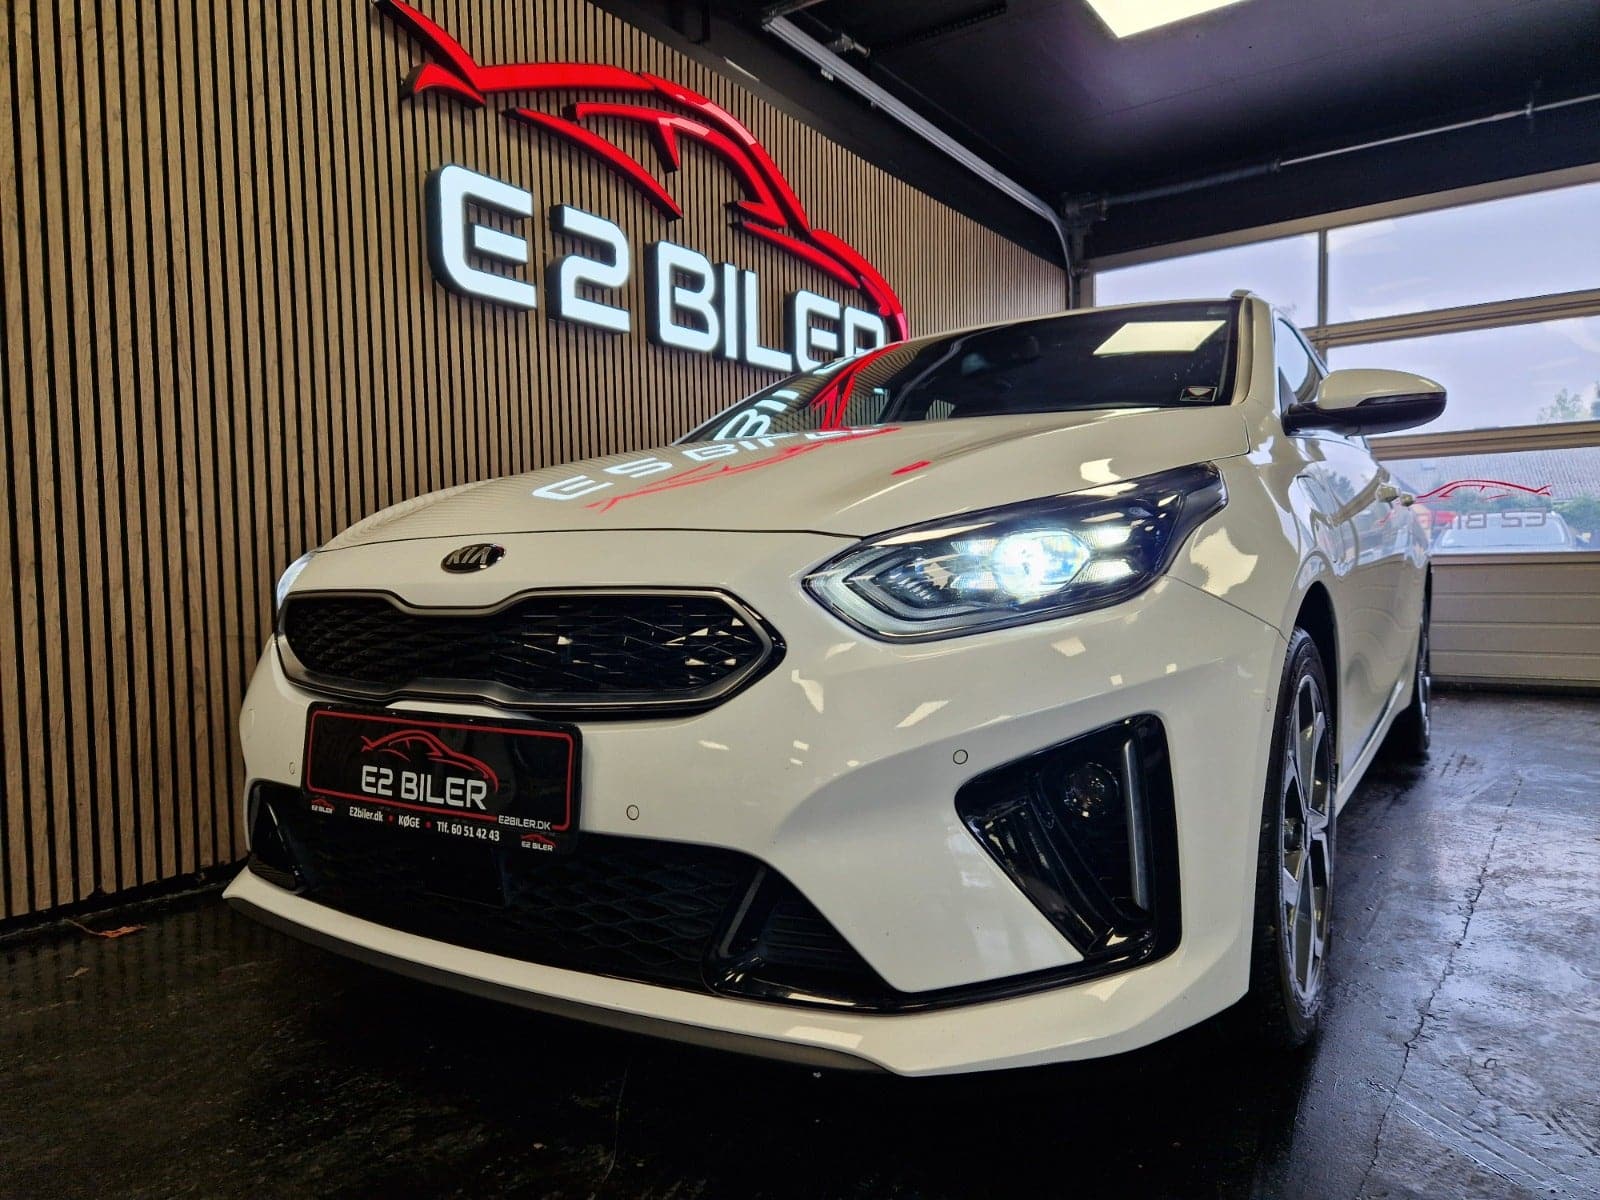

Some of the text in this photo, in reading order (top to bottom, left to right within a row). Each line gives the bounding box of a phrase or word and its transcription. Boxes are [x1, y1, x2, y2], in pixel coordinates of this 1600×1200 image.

[438, 163, 631, 334] E2
[445, 546, 492, 565] KIA
[361, 765, 487, 811] E2 BILER
[349, 806, 384, 823] E2biler.dk
[398, 815, 421, 829] KØGE
[451, 823, 462, 836] 60
[463, 825, 474, 838] 51
[475, 828, 487, 840] 42
[488, 829, 500, 842] 43
[498, 814, 552, 831] E2BILER.DK
[521, 841, 553, 852] E2 BILER
